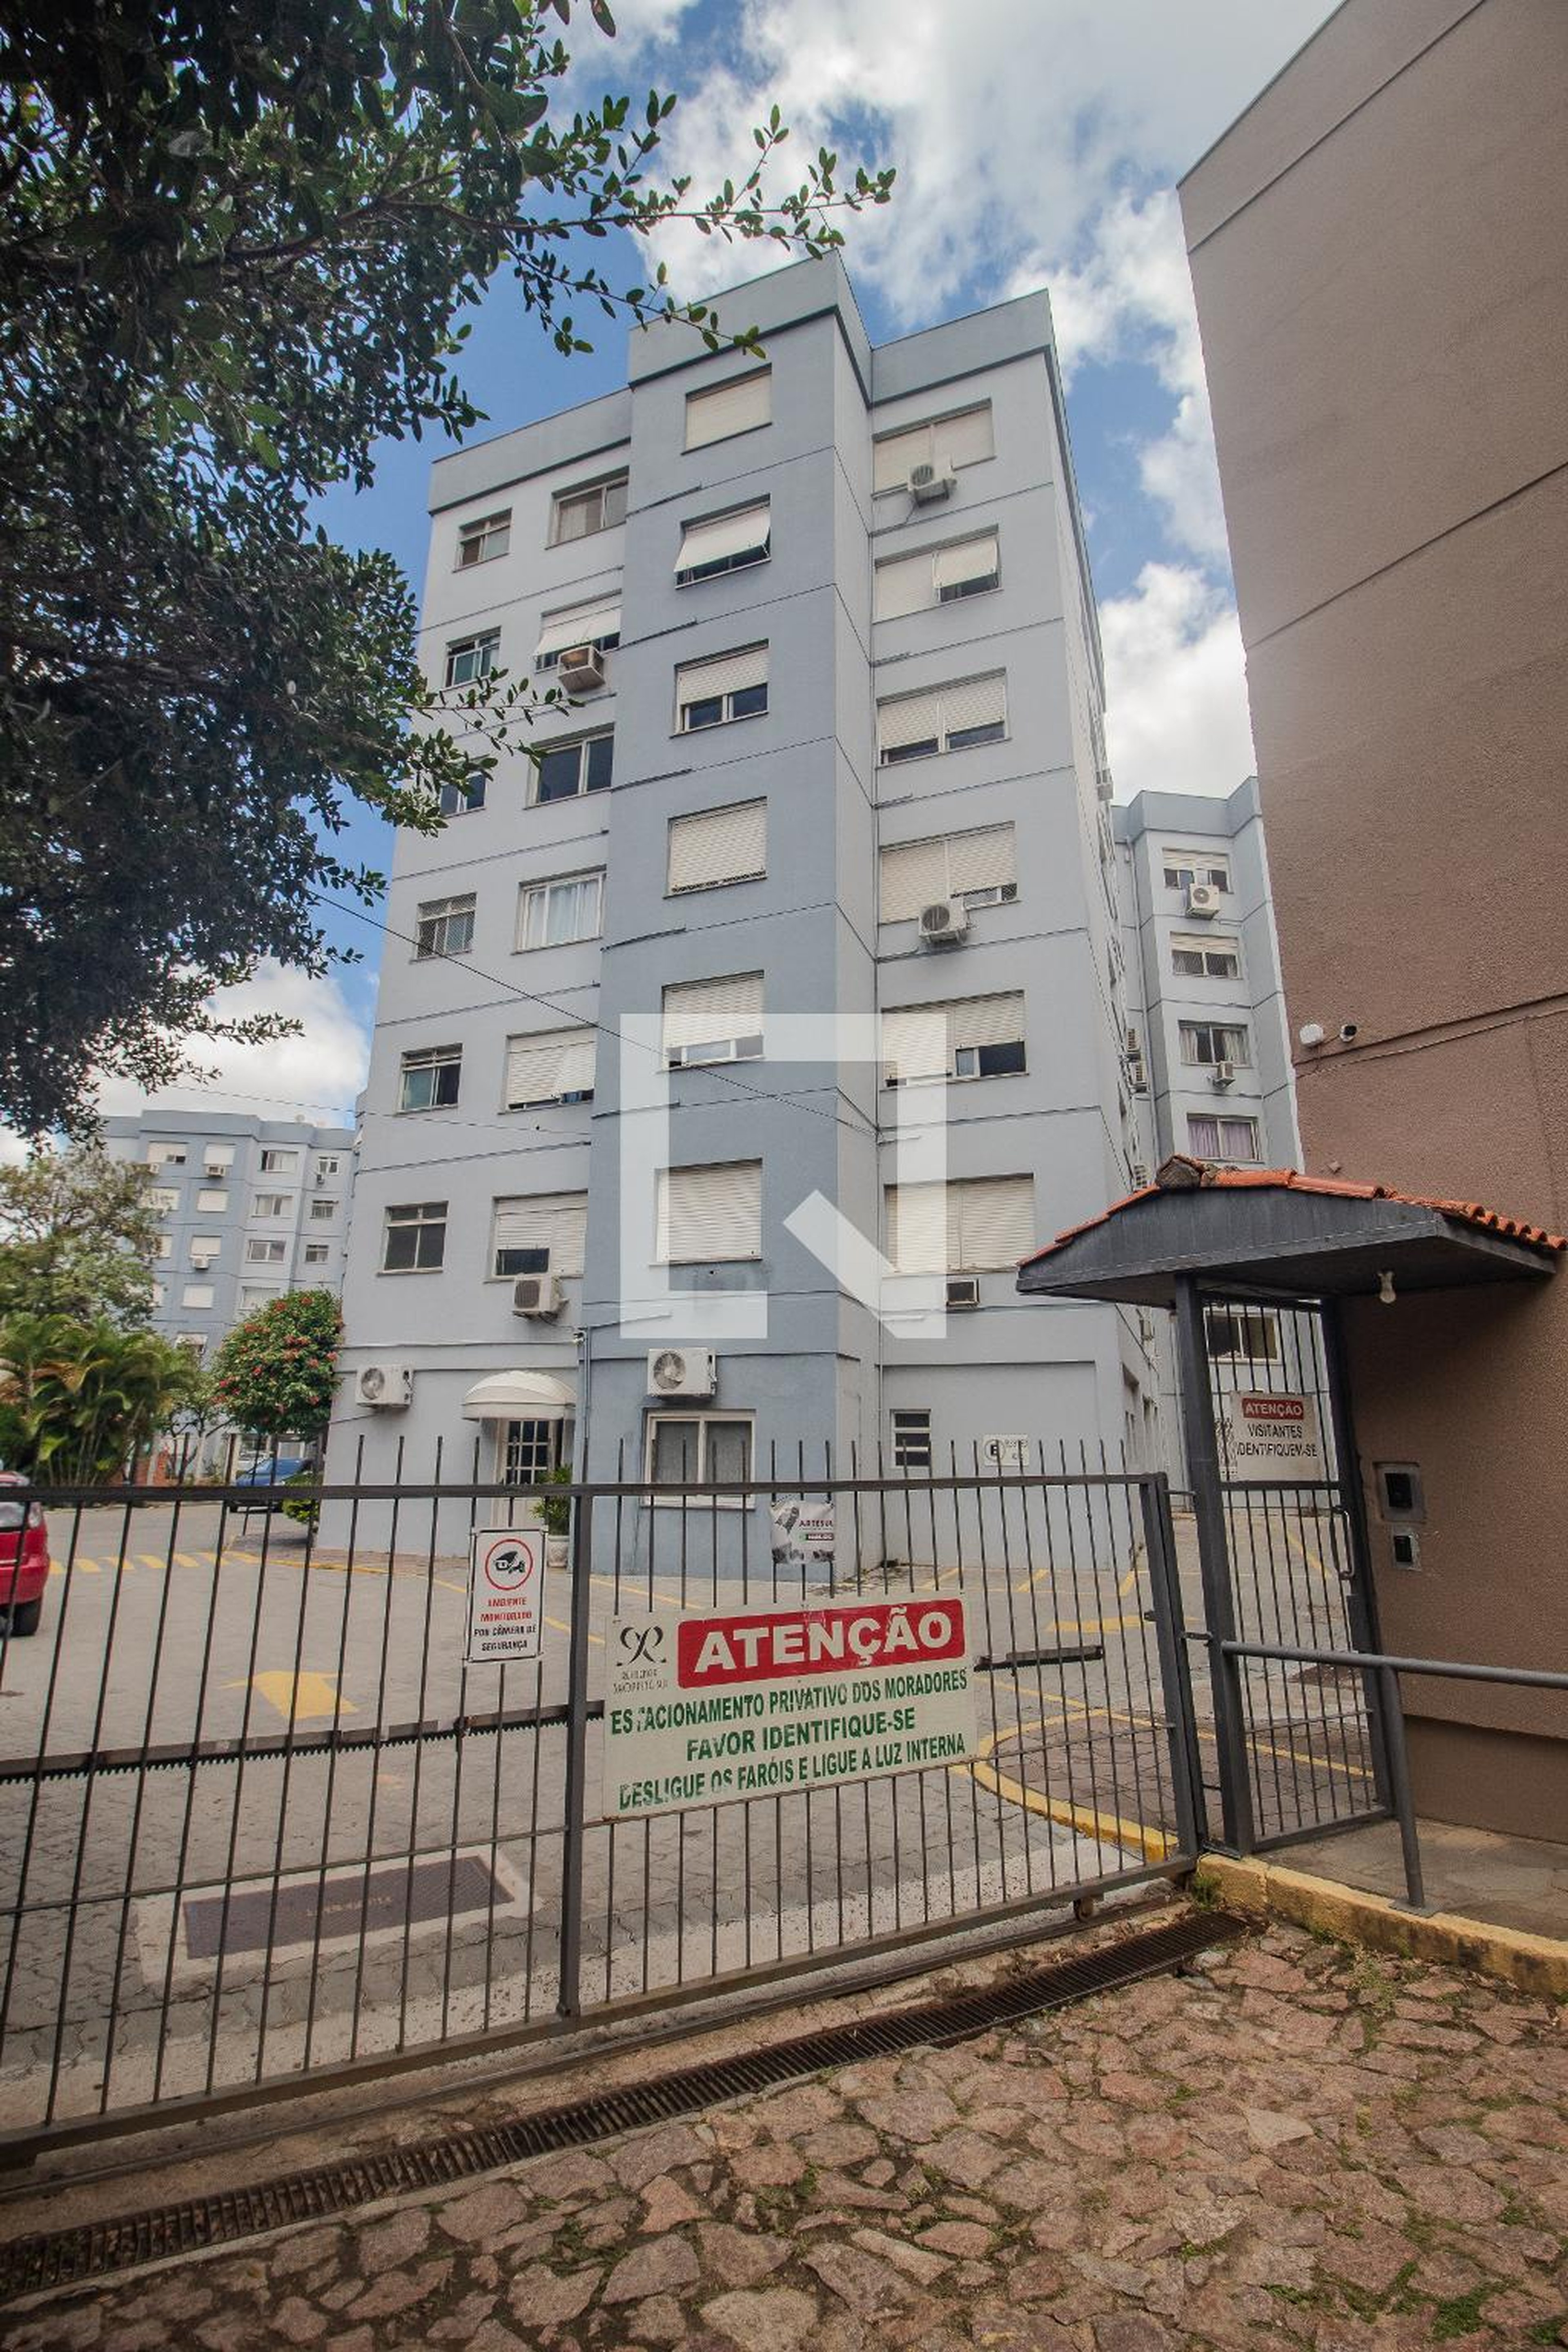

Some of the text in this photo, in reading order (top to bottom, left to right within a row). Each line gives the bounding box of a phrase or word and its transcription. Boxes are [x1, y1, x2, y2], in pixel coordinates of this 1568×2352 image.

[1246, 1402, 1302, 1417] ATENÇÃO
[1247, 1423, 1303, 1439] VISITANTES
[481, 1639, 528, 1652] SEGURANÇA
[694, 1607, 952, 1673] ATENÇÃO
[610, 1668, 967, 1735] ESTACIONAMENTO PRIVATIVO DOS MORADORES
[687, 1707, 915, 1762] FAVOR IDENTIFIQUE-SE
[619, 1733, 966, 1811] DESLIGUE OS FARÓIS E LIGUE A LUZ INTERNA
